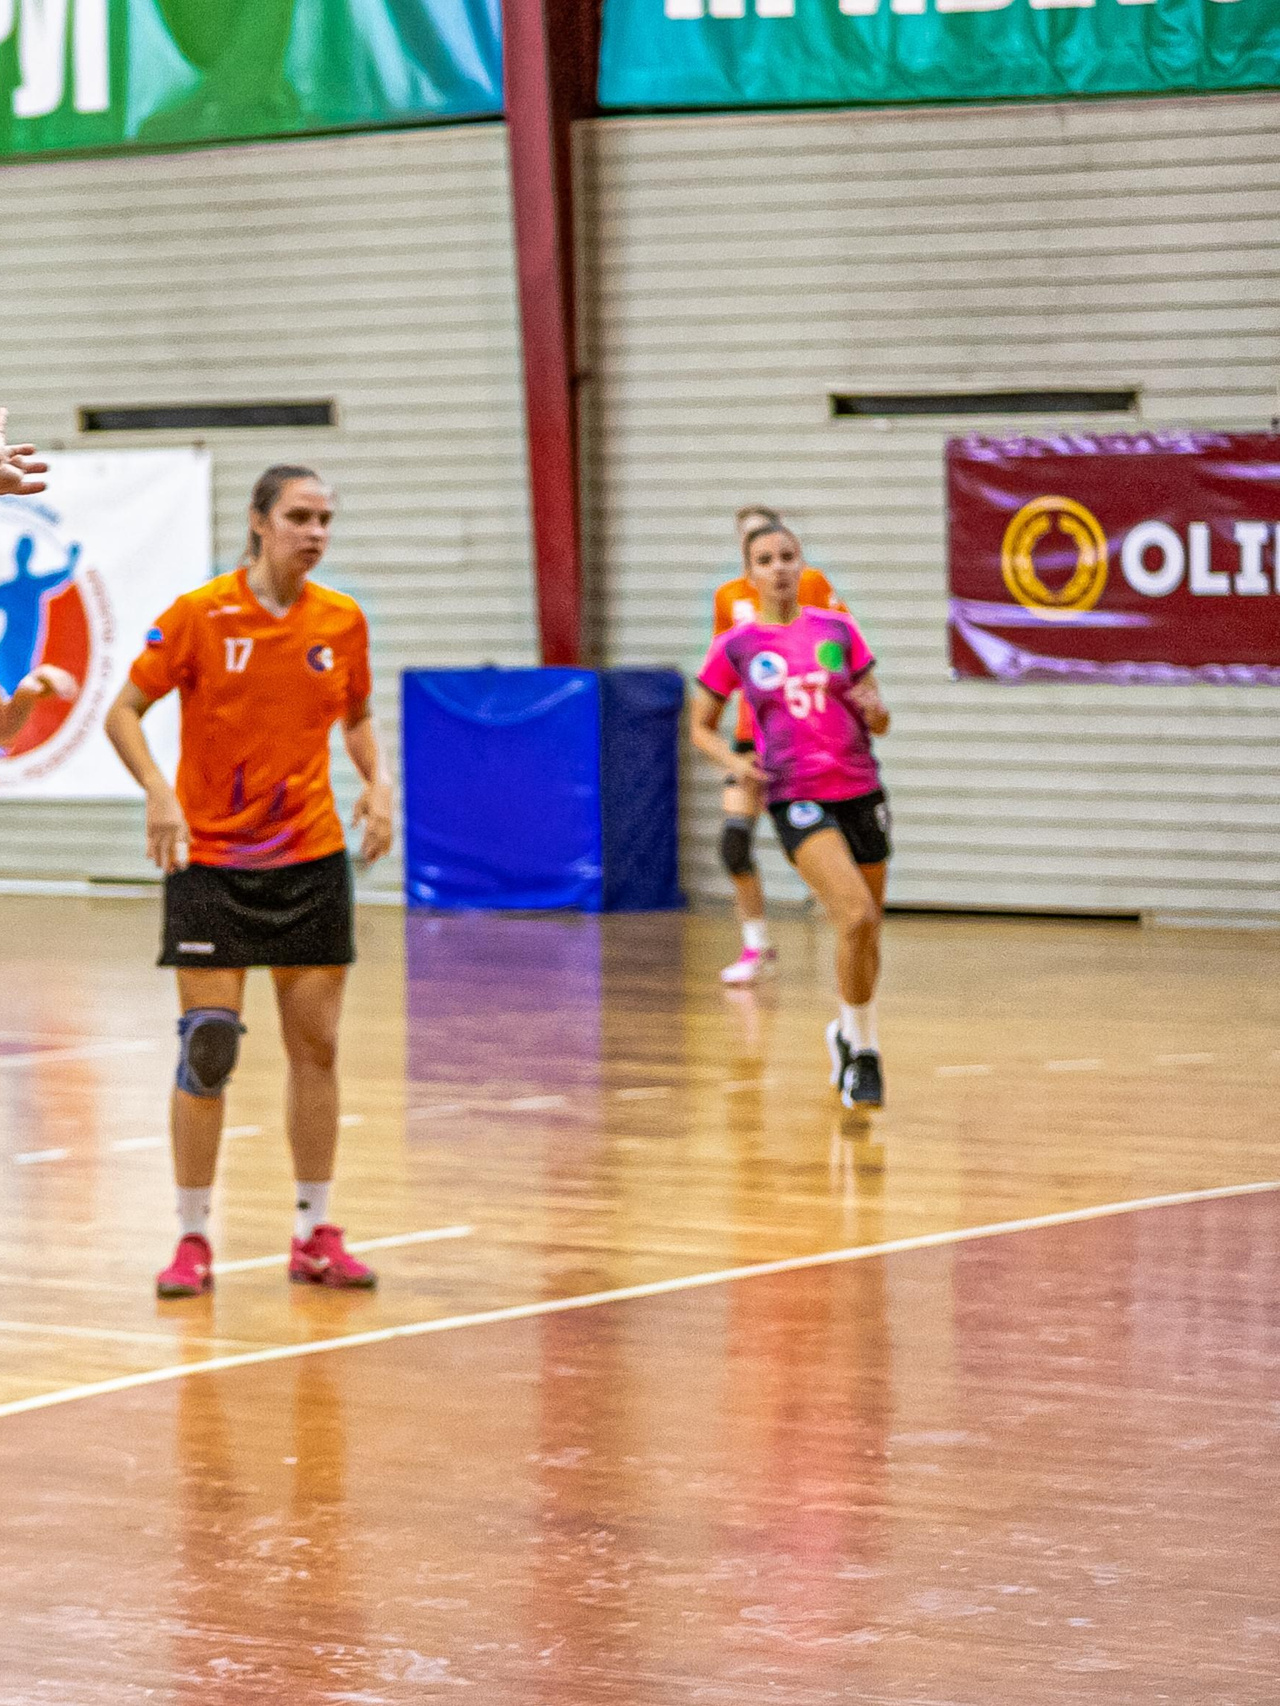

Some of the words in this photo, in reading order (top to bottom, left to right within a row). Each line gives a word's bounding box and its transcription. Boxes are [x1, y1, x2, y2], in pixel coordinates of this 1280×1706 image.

[1121, 519, 1280, 597] OLI
[224, 636, 254, 673] 17
[784, 670, 829, 719] 57
